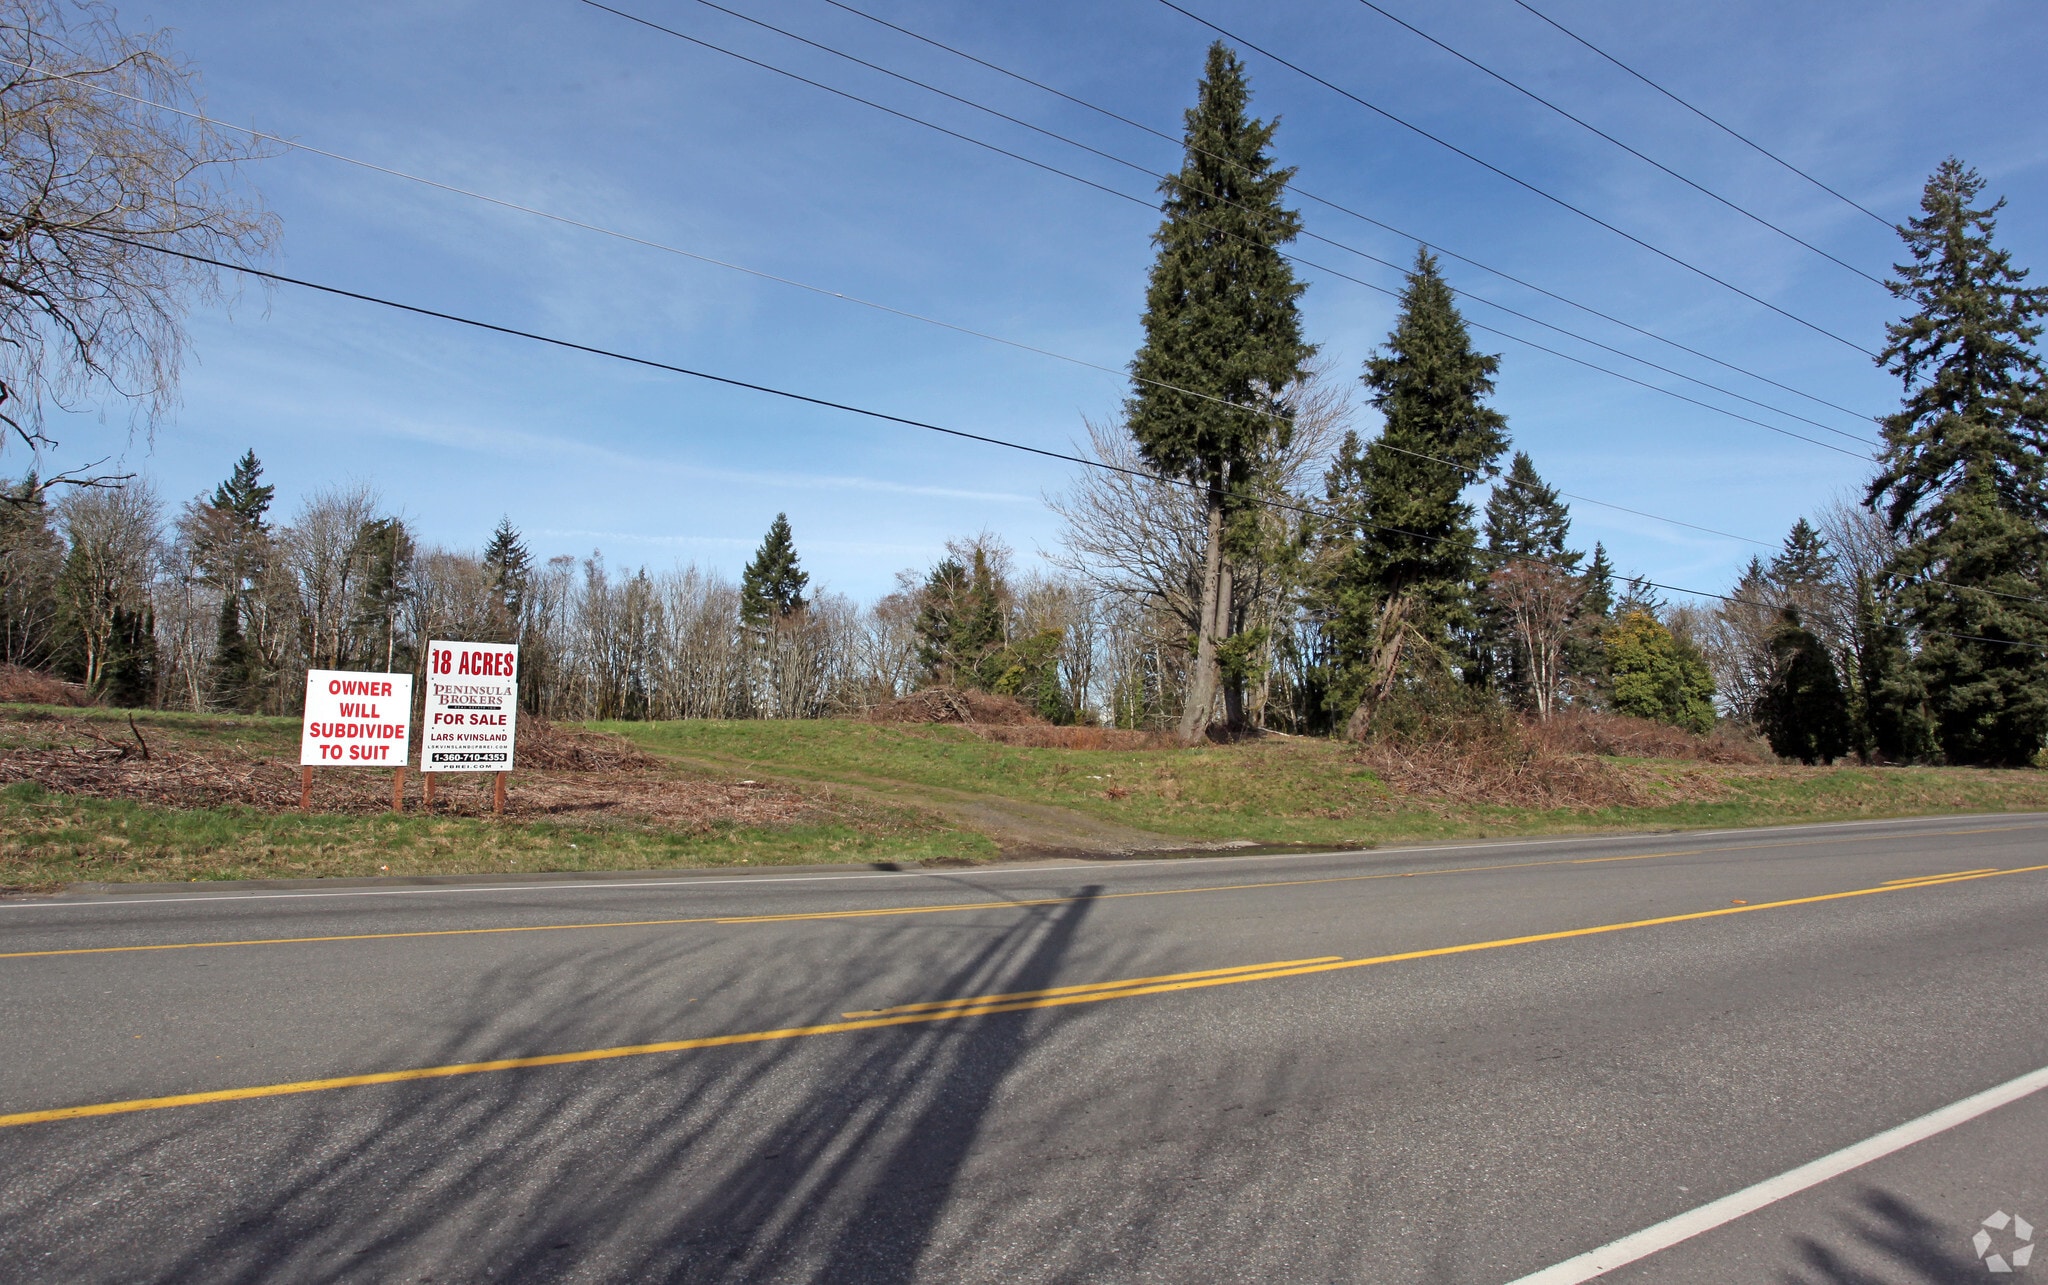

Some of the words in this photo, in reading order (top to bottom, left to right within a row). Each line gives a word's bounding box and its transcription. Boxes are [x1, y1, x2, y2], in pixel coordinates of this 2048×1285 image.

[433, 650, 452, 674] 18
[458, 651, 514, 676] ACRES
[328, 680, 392, 696] OWNER
[433, 684, 512, 696] PENINSULA
[438, 694, 503, 705] BROKERS
[340, 702, 380, 718] WILL
[434, 713, 464, 725] FOR
[470, 714, 507, 726] SALE
[310, 722, 405, 739] SUBDIVIDE
[457, 734, 508, 742] KVINSLAND
[320, 744, 343, 760] TO
[349, 744, 390, 760] SUIT
